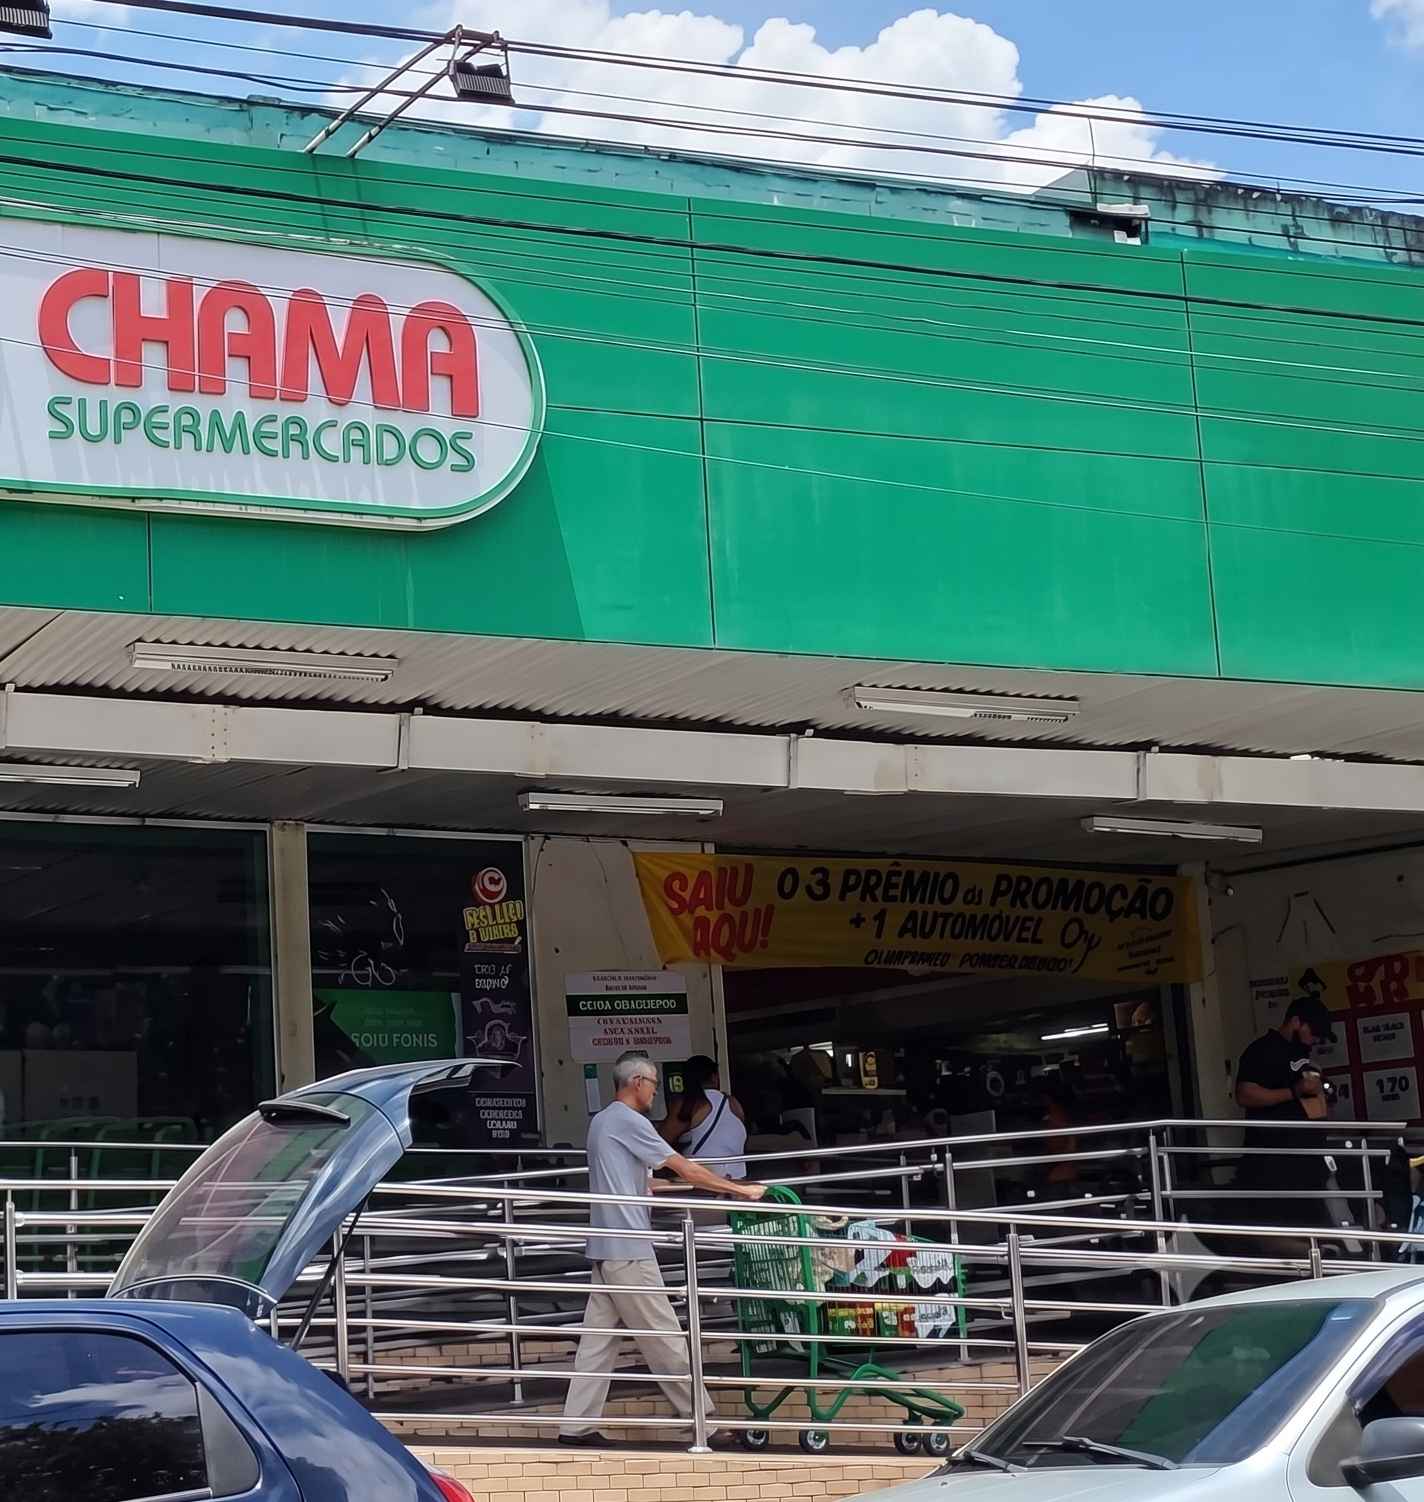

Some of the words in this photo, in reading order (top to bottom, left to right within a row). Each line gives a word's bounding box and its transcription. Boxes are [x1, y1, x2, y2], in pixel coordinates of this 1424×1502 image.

[39, 267, 479, 418] CHAMA
[47, 396, 476, 473] SUPERMERCADOS
[663, 863, 754, 915] SAIU
[838, 860, 960, 906] PRÊMIO
[989, 873, 1174, 923] PROMOÇÃO
[897, 909, 1044, 944] AUTOMÓVEL
[1376, 1075, 1410, 1094] 170
